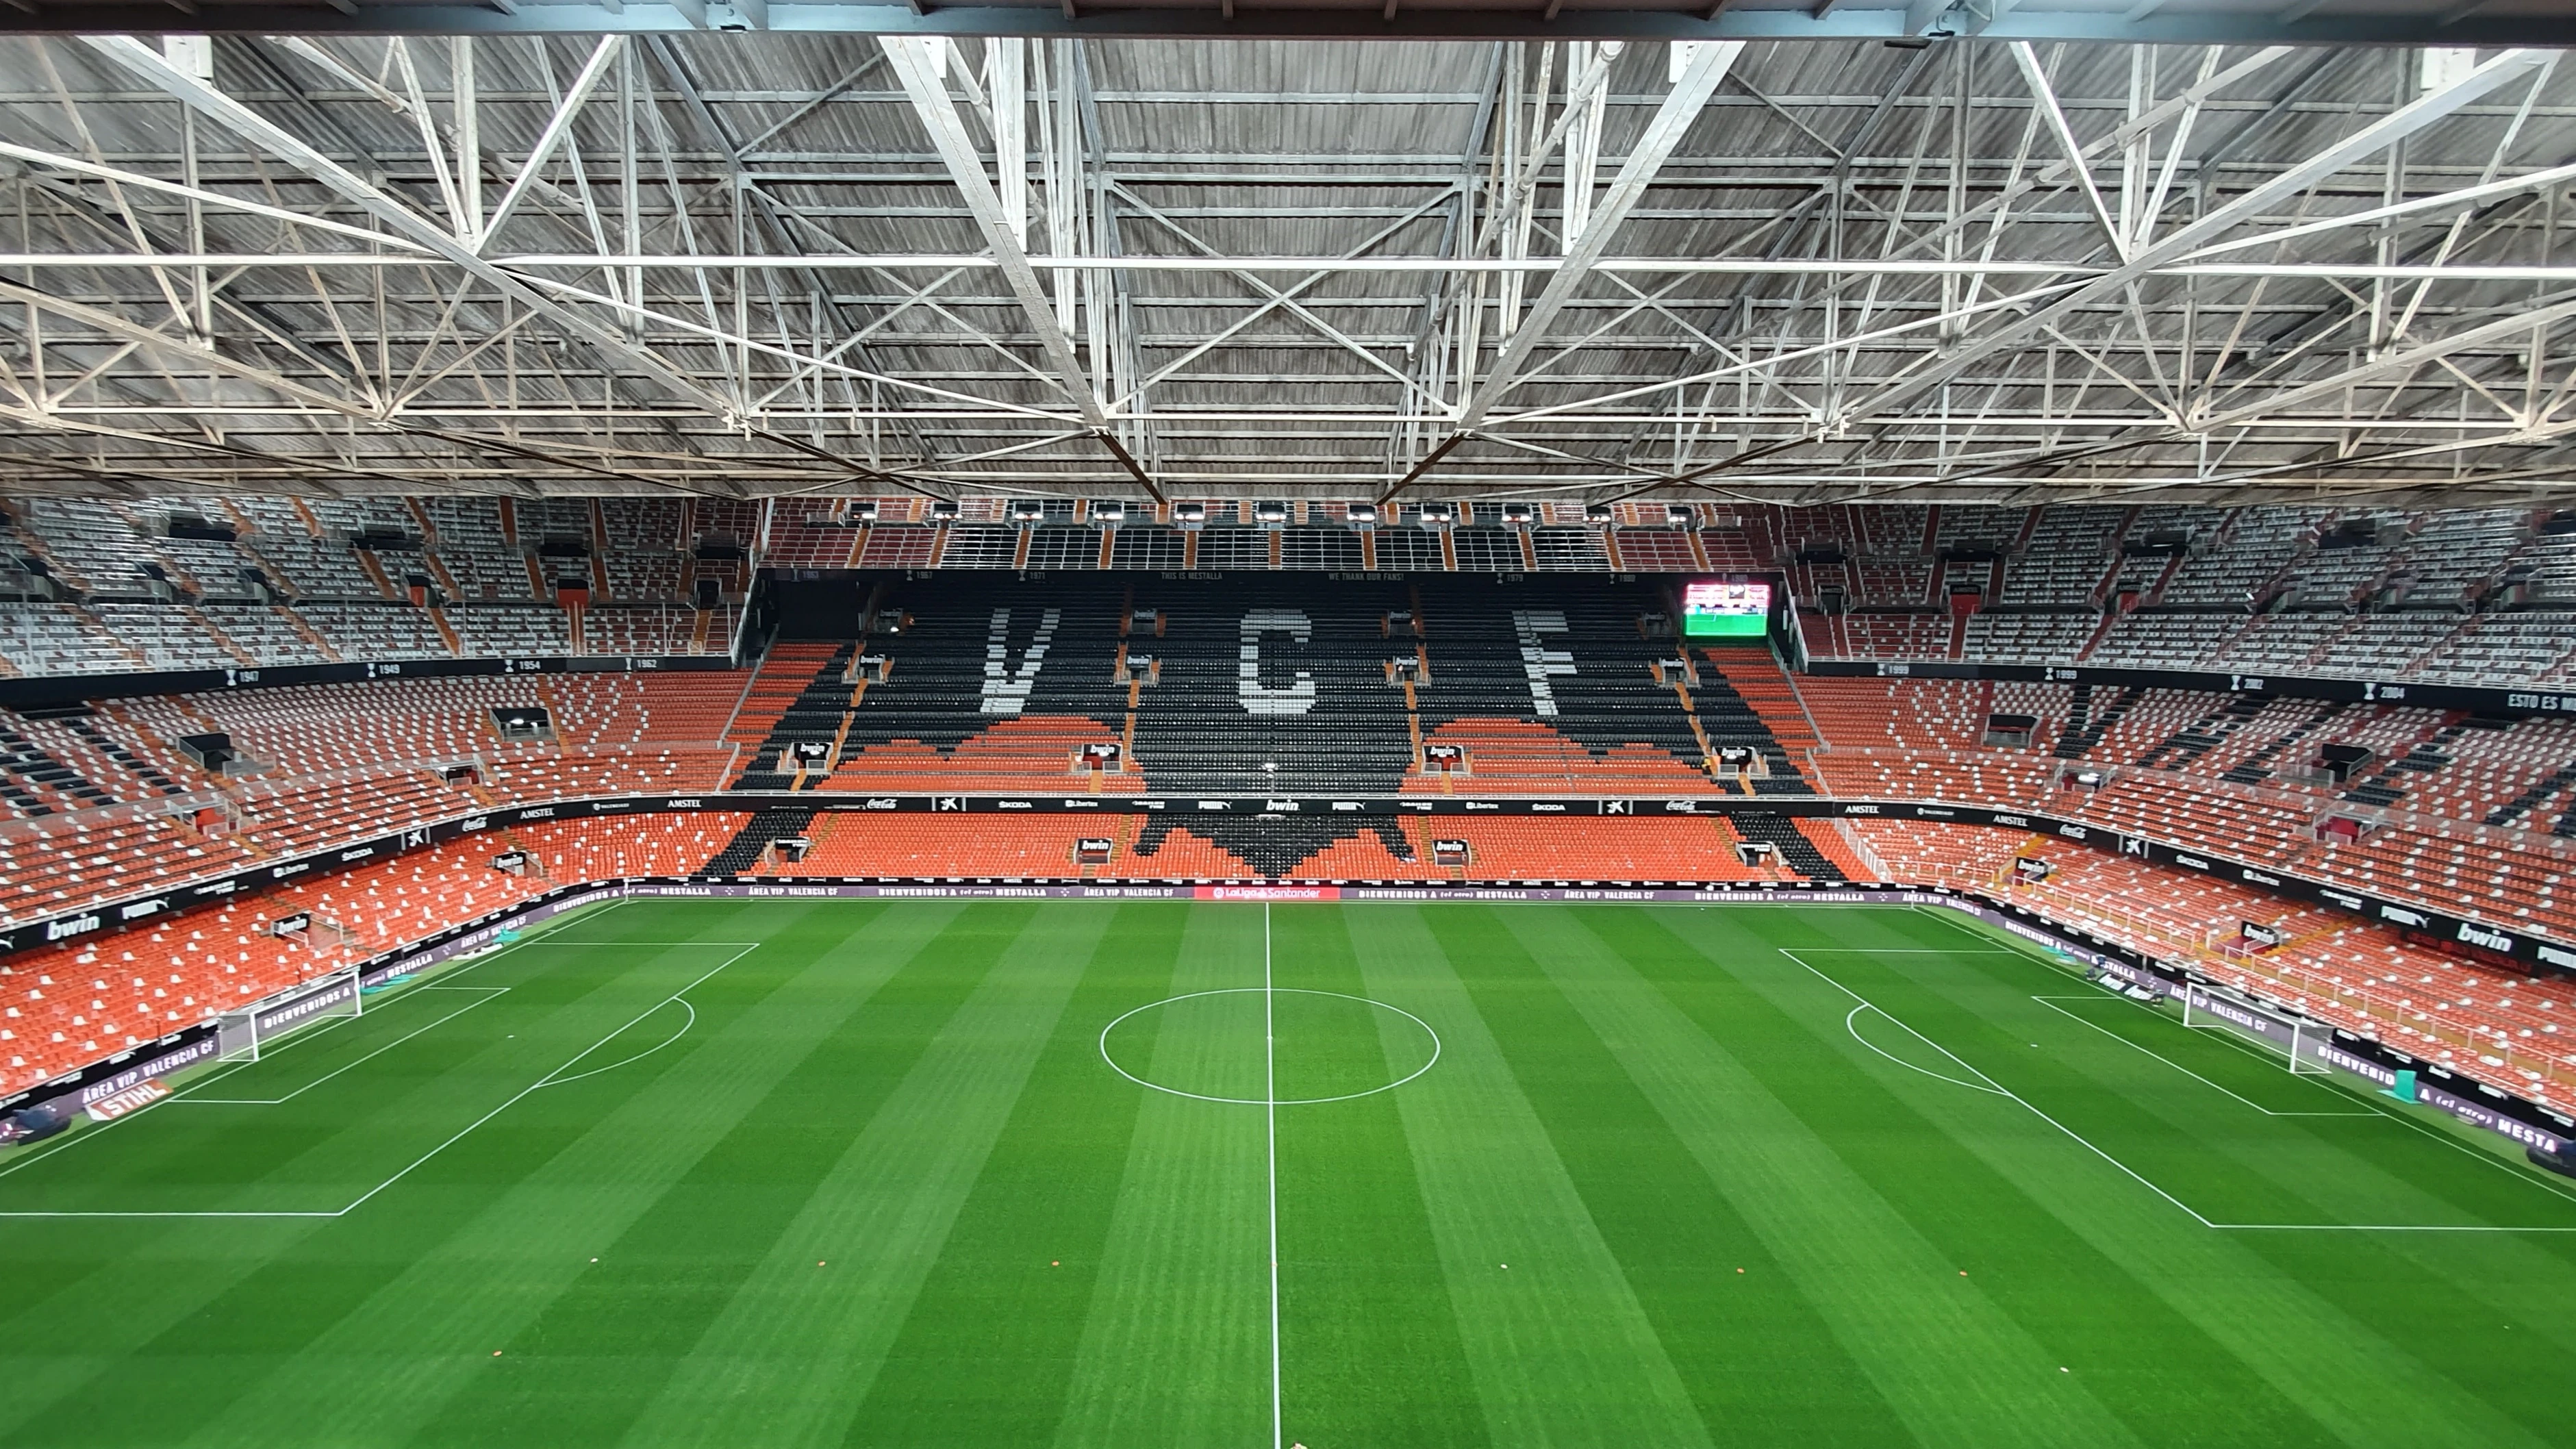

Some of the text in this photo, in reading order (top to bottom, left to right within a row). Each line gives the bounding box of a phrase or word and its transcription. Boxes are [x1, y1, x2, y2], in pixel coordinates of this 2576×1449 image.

[1161, 572, 1223, 580] THIS IS MESTALLA
[1328, 572, 1404, 581] WE THANK OUR FANS!
[379, 664, 400, 675] 1949
[518, 660, 541, 670] 1954
[637, 659, 657, 669] 1962
[2508, 694, 2539, 708] ESTO
[2541, 696, 2559, 710] ES
[800, 743, 825, 753] bwin
[1090, 744, 1115, 754] bwin
[1430, 746, 1455, 757] bwin
[668, 799, 702, 808] AMSTEL
[1266, 798, 1299, 811] bwin
[1532, 803, 1566, 811] ŠKODA
[520, 807, 555, 820] AMSTEL
[1845, 805, 1880, 814] AMSTEL
[1993, 815, 2028, 827] AMSTEL
[1083, 840, 1109, 850] bwin
[1437, 841, 1463, 852] bwin
[748, 886, 769, 896] ÁREA
[879, 888, 947, 896] BIENVENIDOS
[996, 888, 1046, 896] MESTALLA
[1084, 887, 1174, 896] ÁREA VIP VALENCIA CF
[1225, 887, 1320, 899] LaLiga Santander
[1359, 890, 1427, 898] BIENVENIDOS
[1564, 890, 1584, 899] ÁREA
[1604, 891, 1642, 899] VALENCIA
[1695, 892, 1764, 900] BIENVENIDOS
[1813, 893, 1865, 901] MESTALLA
[553, 892, 609, 913] BIENVENIDOS
[1927, 894, 1943, 905] VIP
[47, 912, 100, 940] bwin
[478, 930, 490, 942] VIP
[2005, 920, 2055, 948] BIENVENIDOS
[2056, 942, 2062, 950] A
[2457, 922, 2512, 952] bwin
[264, 992, 340, 1029] BIENVENIDOS
[343, 987, 351, 997] A
[387, 954, 433, 979] MESTALLA
[2193, 994, 2208, 1008] VIP
[2210, 1002, 2253, 1027] VALENCIA
[2254, 1019, 2268, 1032] CF
[82, 1040, 214, 1104] ÁREA VIP VALENCIA CF
[2318, 1046, 2395, 1086] BIENVENID
[2419, 1088, 2430, 1102] A
[105, 1083, 166, 1116] STIHL
